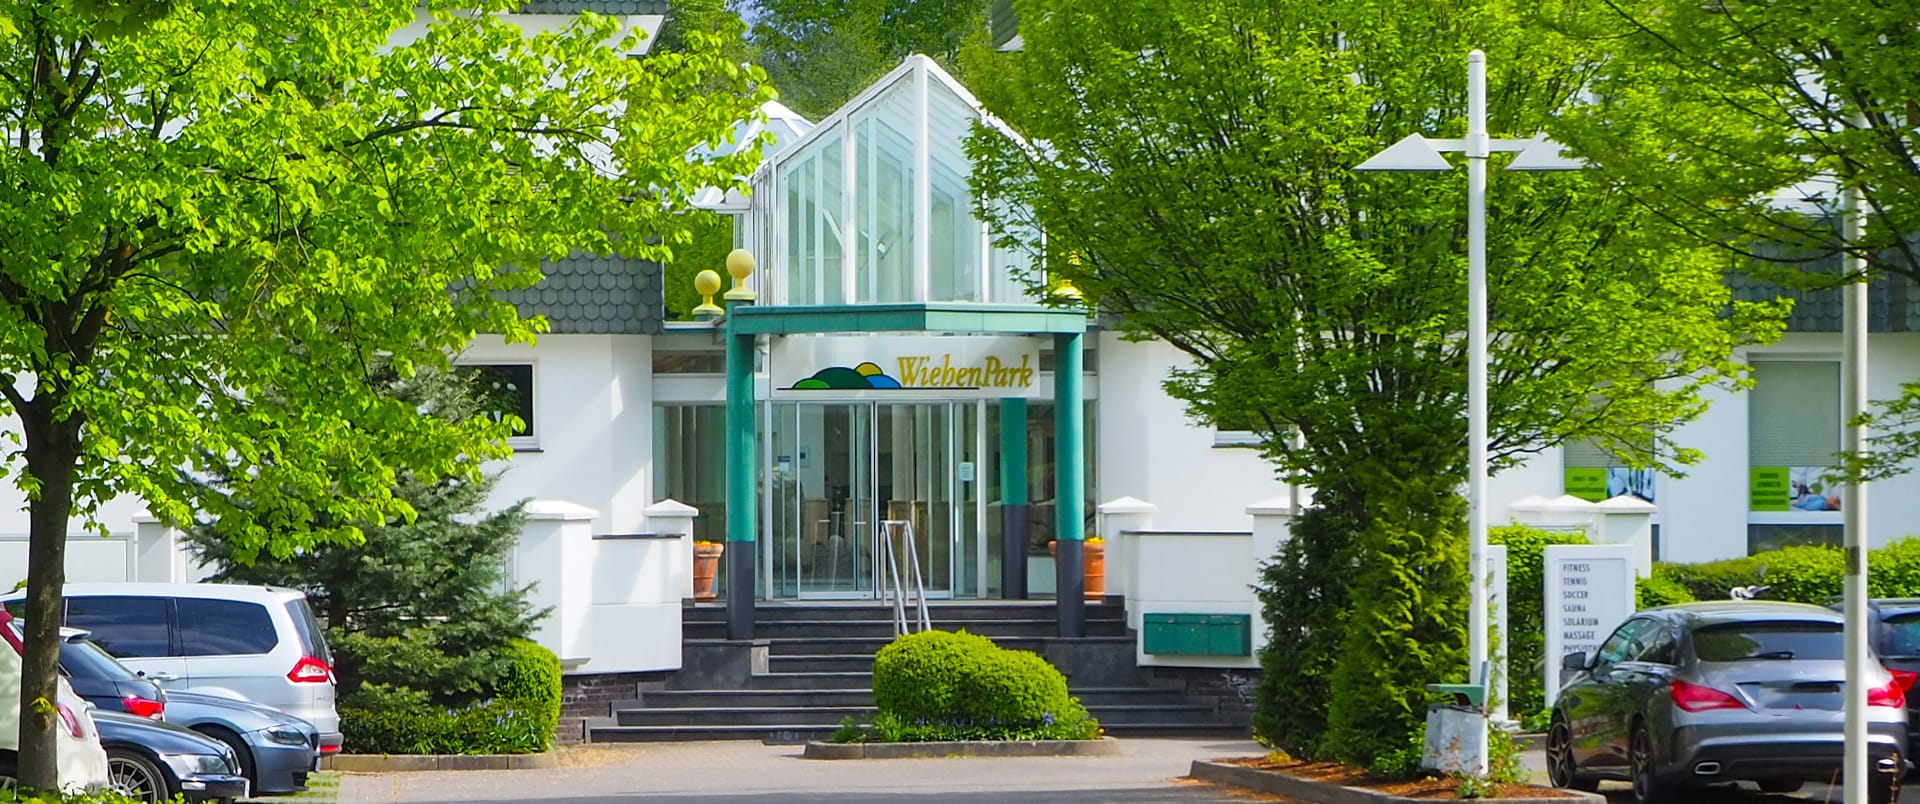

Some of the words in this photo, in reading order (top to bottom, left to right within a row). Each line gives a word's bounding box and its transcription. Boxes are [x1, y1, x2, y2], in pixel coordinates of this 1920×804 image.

[896, 353, 1034, 388] WiehenPark
[1563, 564, 1590, 572] FITNESS
[1563, 577, 1587, 585] TENNIS
[1563, 591, 1588, 599] SOCCER
[1563, 604, 1586, 612] SAUNA
[1563, 618, 1599, 626] SOLARIUM
[1563, 631, 1595, 640] MASSAGE
[1563, 644, 1601, 653] PHYSIOTH
